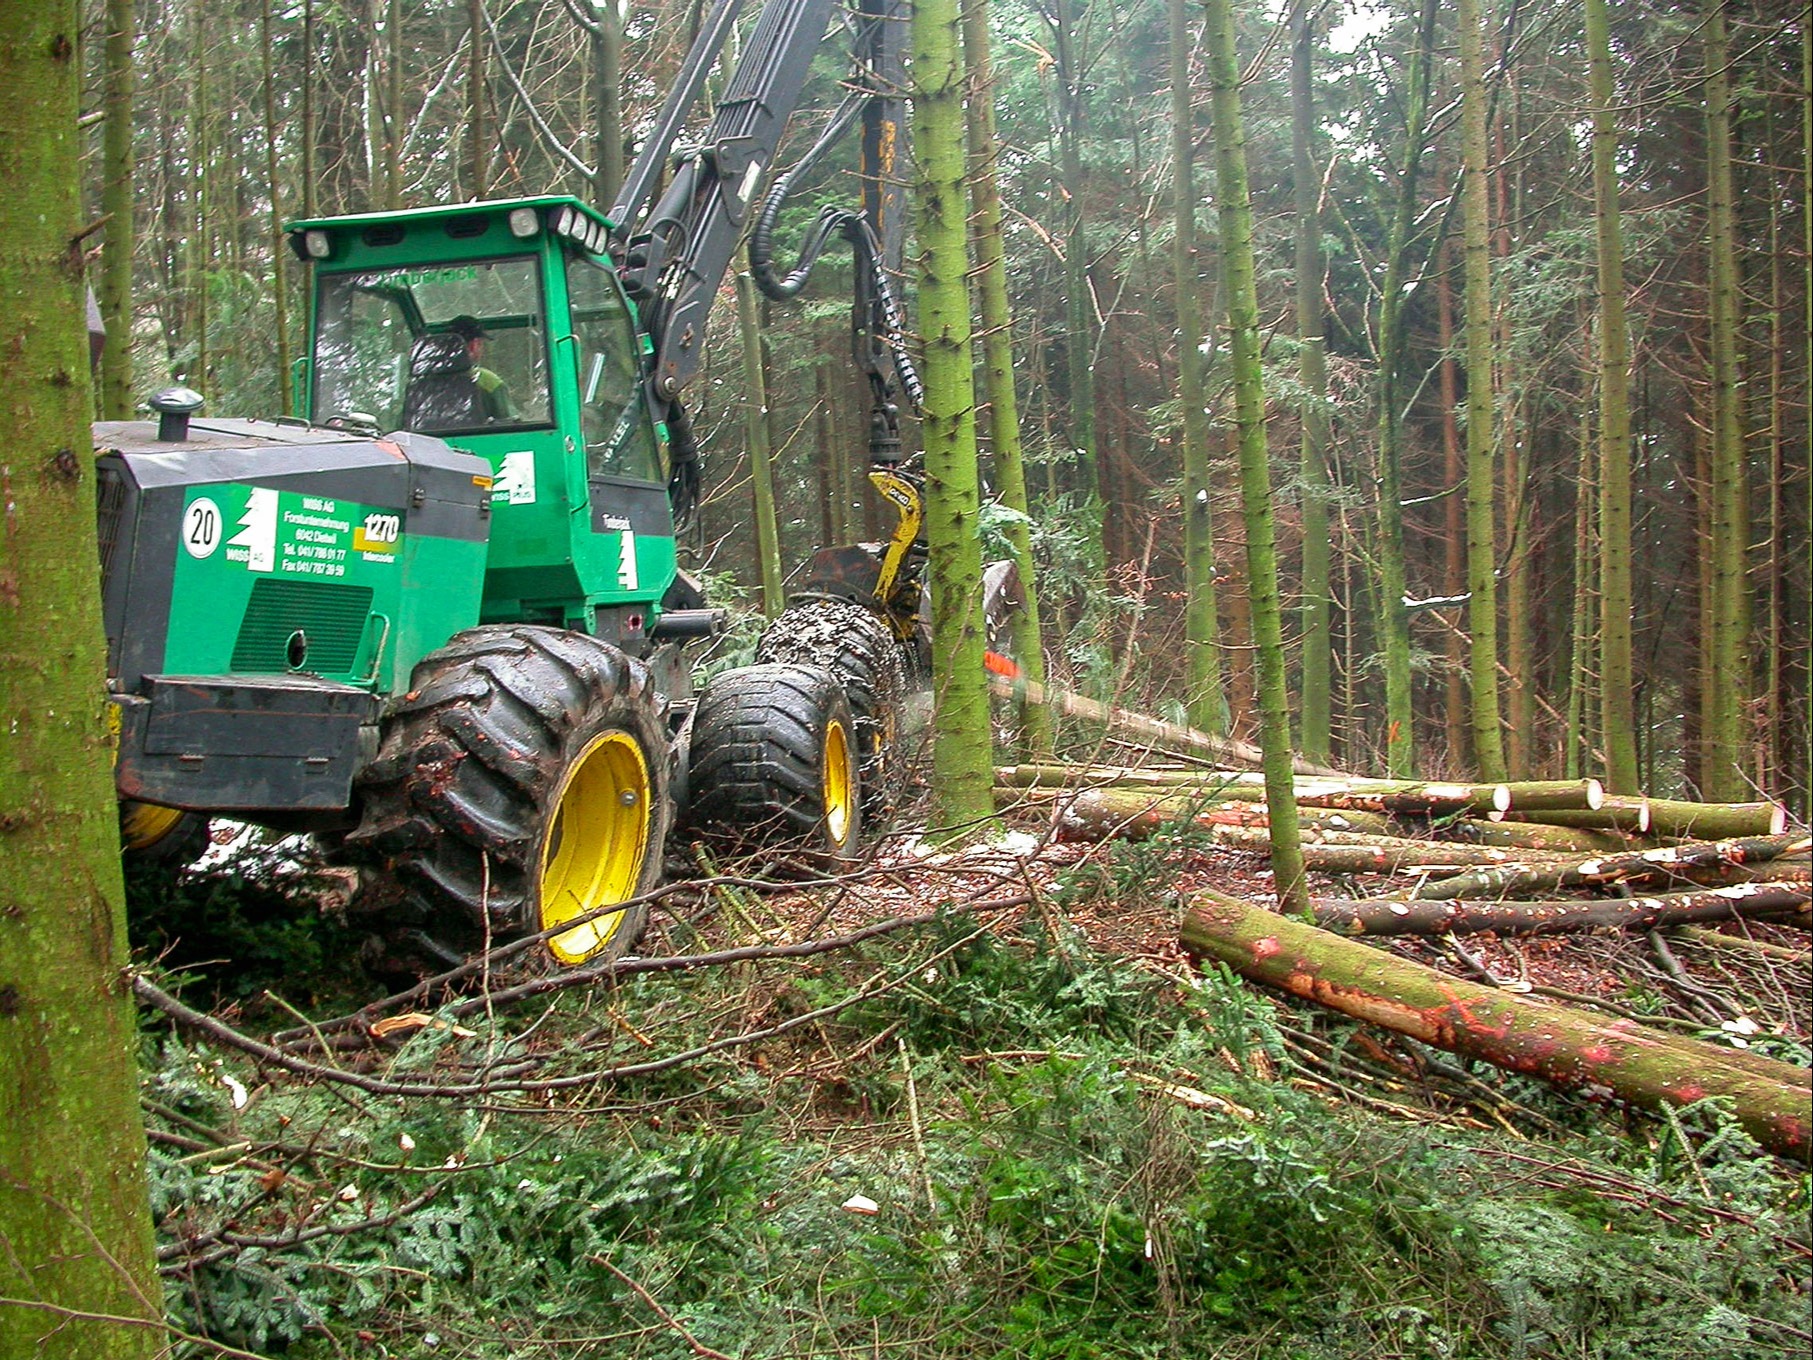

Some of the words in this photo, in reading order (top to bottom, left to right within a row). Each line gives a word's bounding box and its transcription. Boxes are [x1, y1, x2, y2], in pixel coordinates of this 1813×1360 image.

[323, 501, 335, 513] AG
[190, 508, 214, 546] 20
[363, 513, 400, 543] 1270
[226, 548, 250, 563] WISS
[336, 549, 346, 561] 77
[281, 559, 297, 571] Fax
